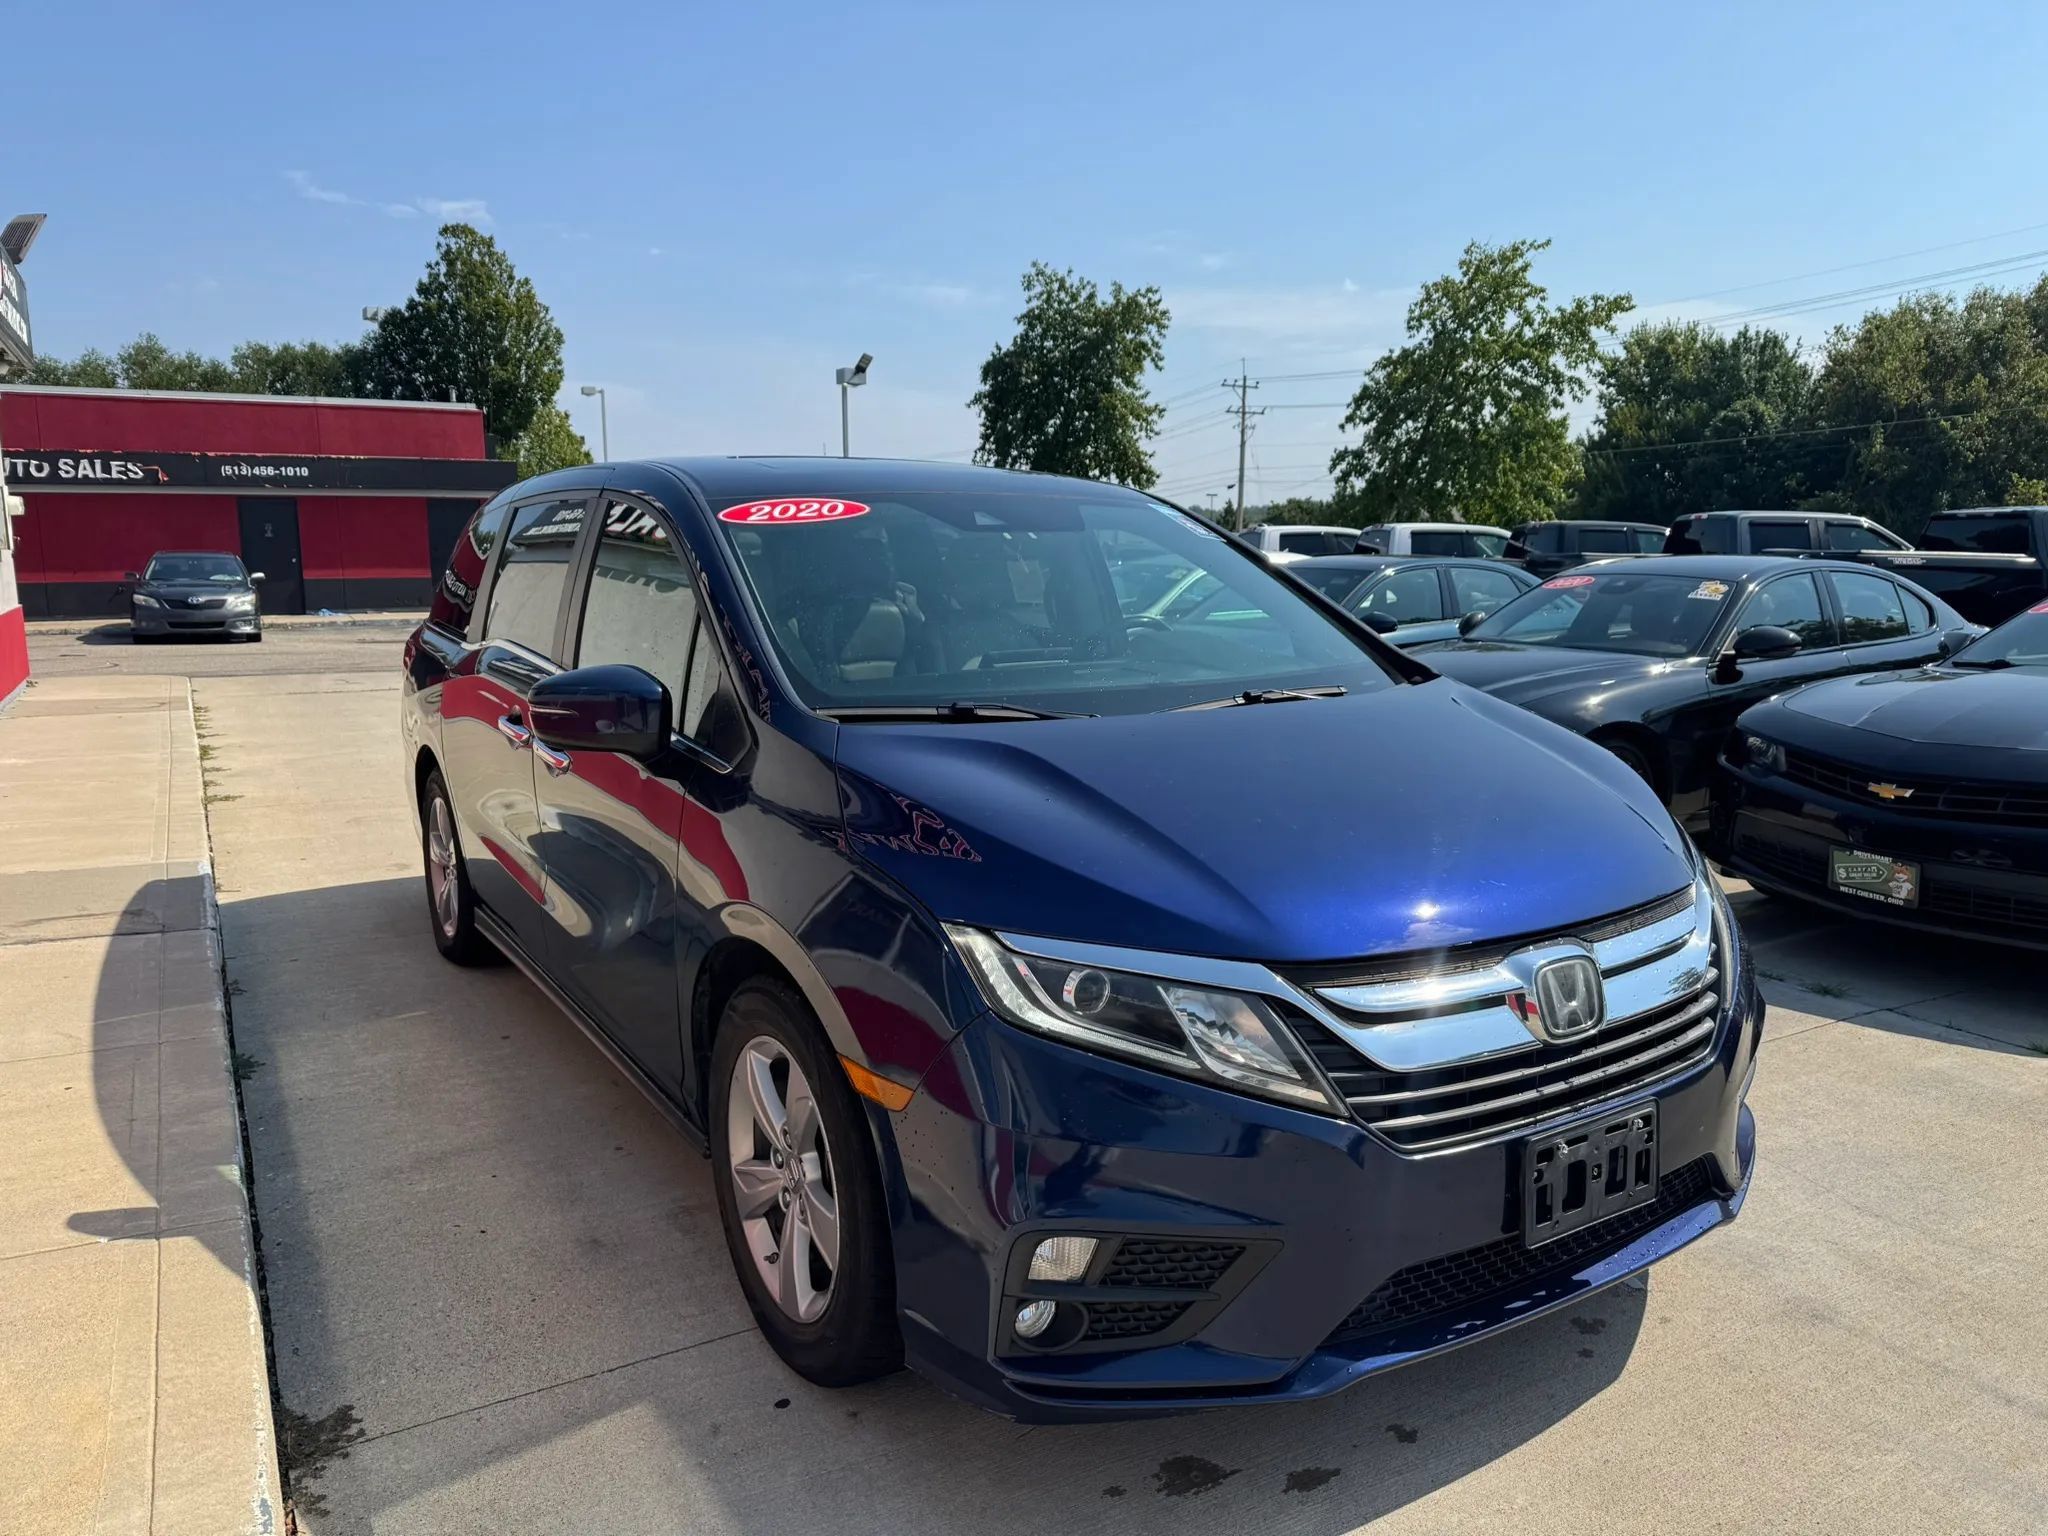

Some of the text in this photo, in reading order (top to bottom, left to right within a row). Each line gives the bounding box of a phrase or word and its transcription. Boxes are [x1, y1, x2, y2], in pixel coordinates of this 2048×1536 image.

[58, 458, 144, 480] SALES
[221, 465, 309, 477] (513)456-1010
[746, 501, 845, 521] 2020
[1840, 886, 1856, 895] WEST
[1888, 897, 1904, 906] OHIO
